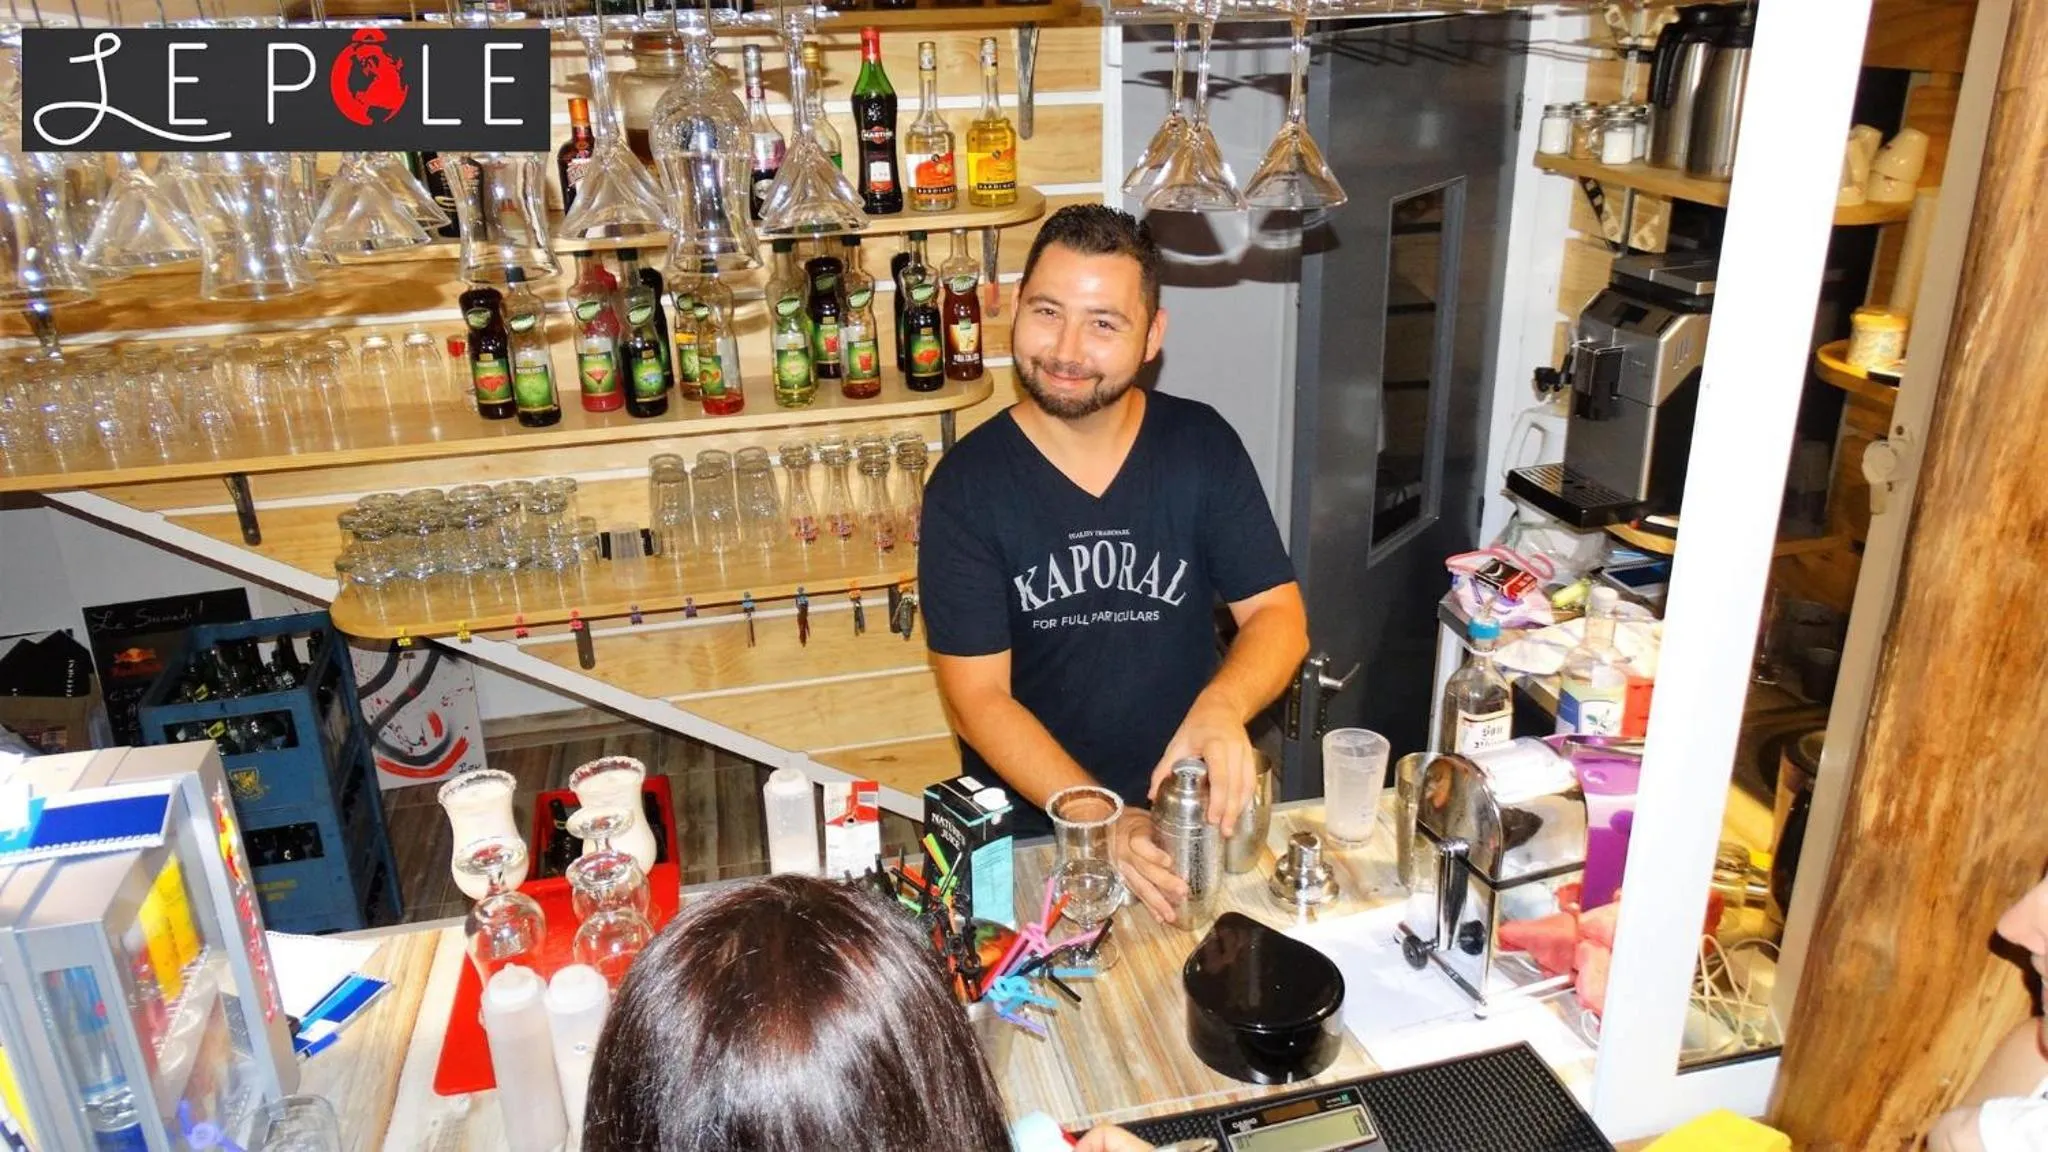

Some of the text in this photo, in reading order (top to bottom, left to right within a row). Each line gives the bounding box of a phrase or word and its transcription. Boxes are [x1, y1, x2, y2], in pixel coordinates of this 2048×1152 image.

[1013, 540, 1188, 612] KAPORAL
[1032, 610, 1160, 629] FOR FULL PARICULARS
